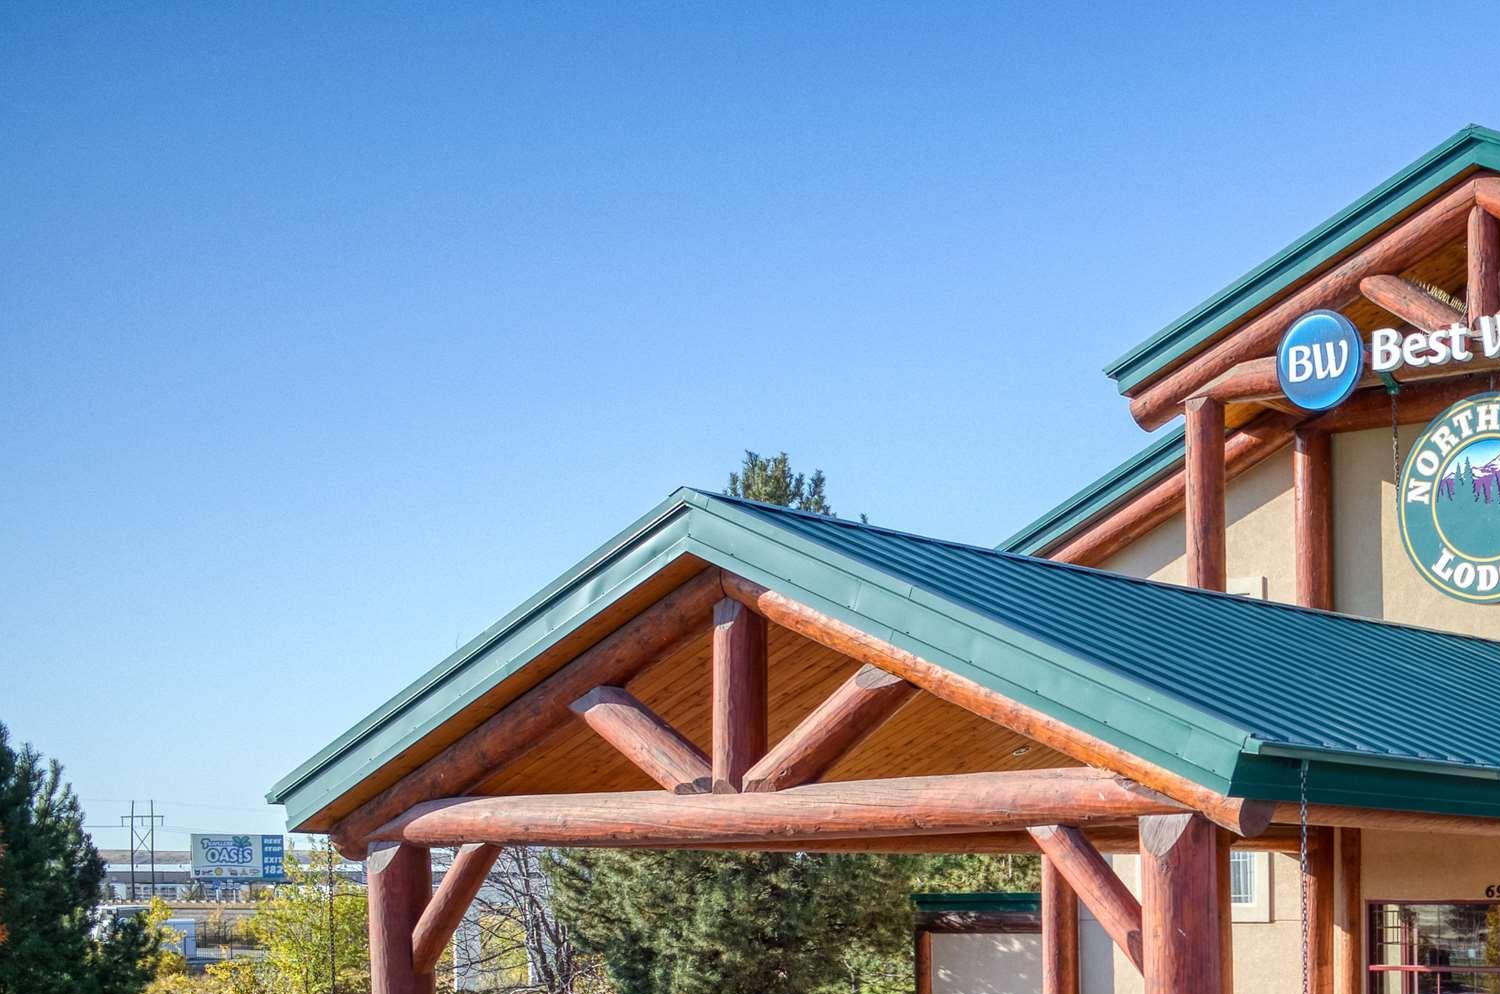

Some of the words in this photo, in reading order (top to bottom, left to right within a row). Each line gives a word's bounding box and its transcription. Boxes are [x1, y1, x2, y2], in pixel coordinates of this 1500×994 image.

[1371, 322, 1473, 371] Best
[1288, 340, 1348, 383] BW
[206, 848, 252, 863] OASIS
[265, 865, 283, 873] 182
